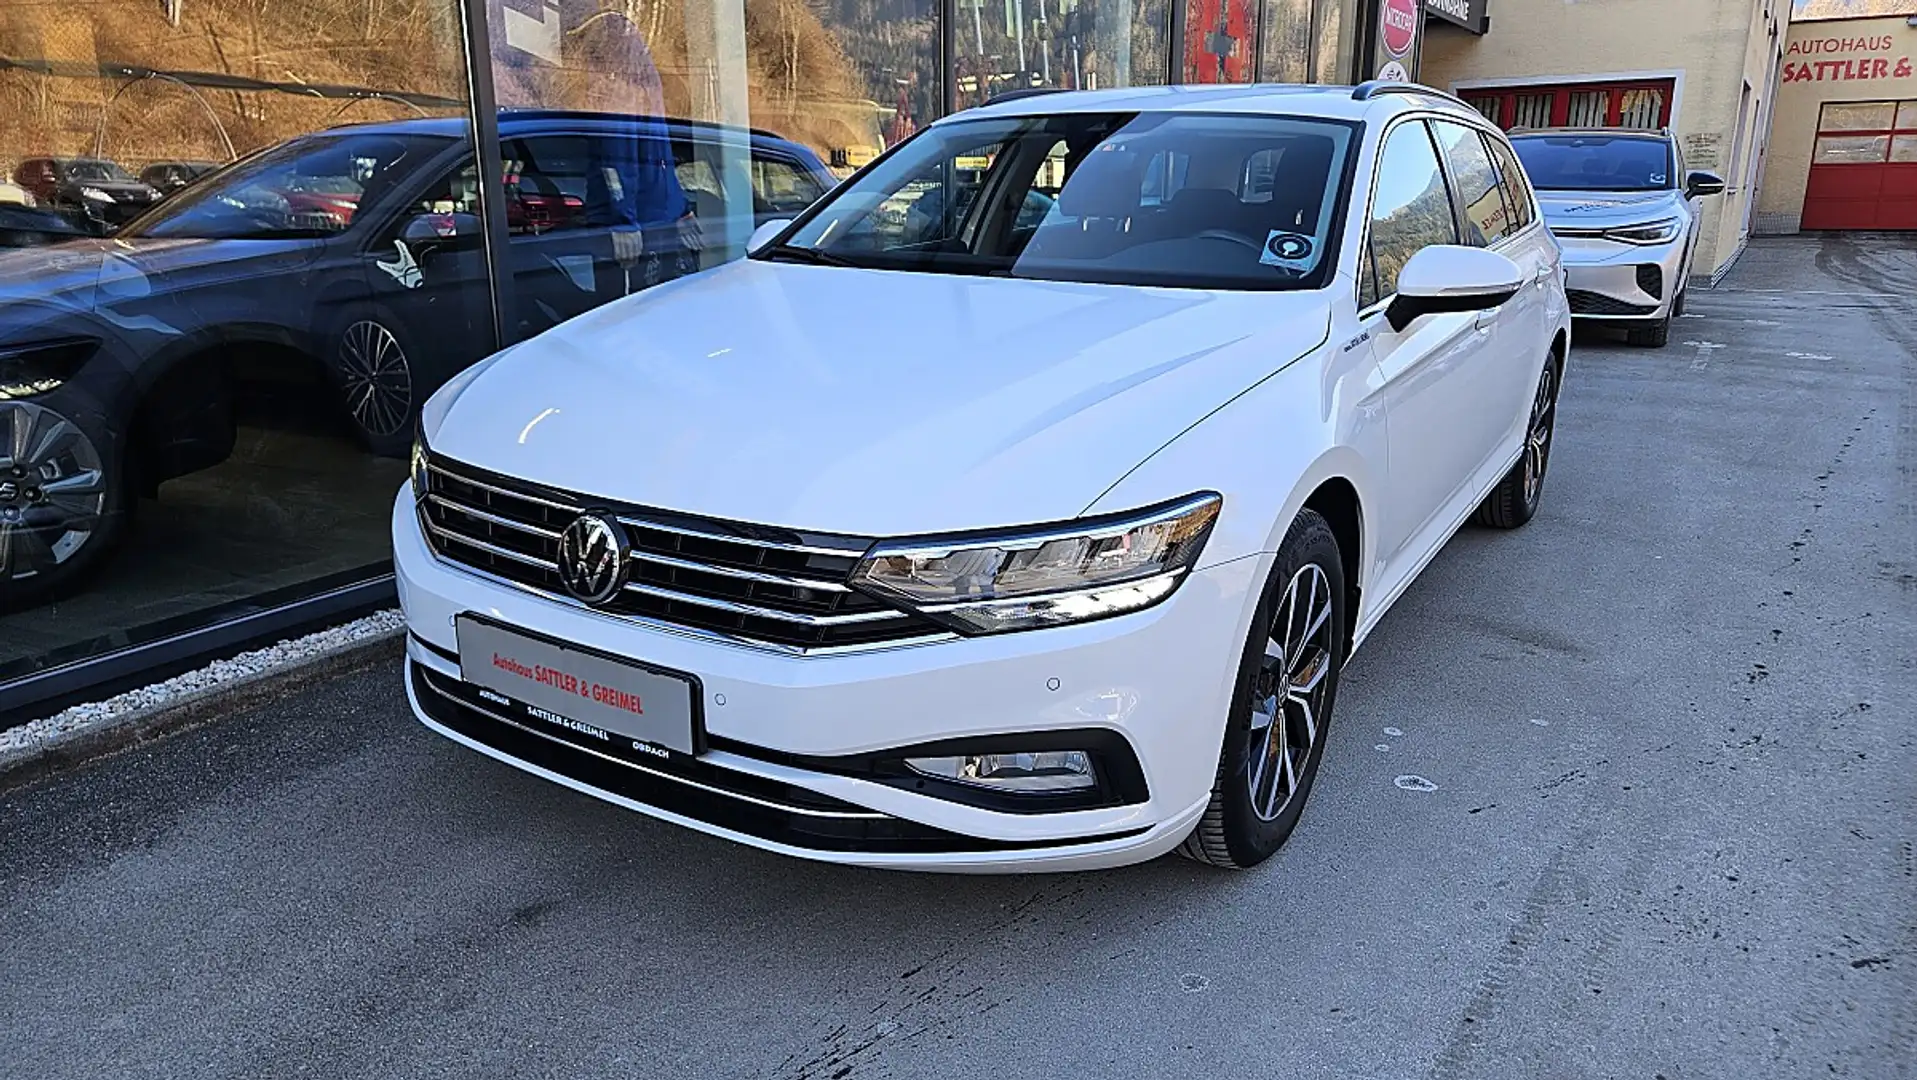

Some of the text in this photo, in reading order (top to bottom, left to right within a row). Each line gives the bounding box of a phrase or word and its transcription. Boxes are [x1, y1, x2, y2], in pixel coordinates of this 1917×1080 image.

[1787, 35, 1893, 55] AUTOHAUS
[1782, 57, 1912, 83] SATTLER &
[493, 652, 643, 715] Autohaus SATTLER & GREIMEL
[527, 706, 562, 726] SATTLER
[563, 718, 570, 728] &
[571, 720, 610, 742] GREIMEL
[632, 740, 670, 759] OBDACH
